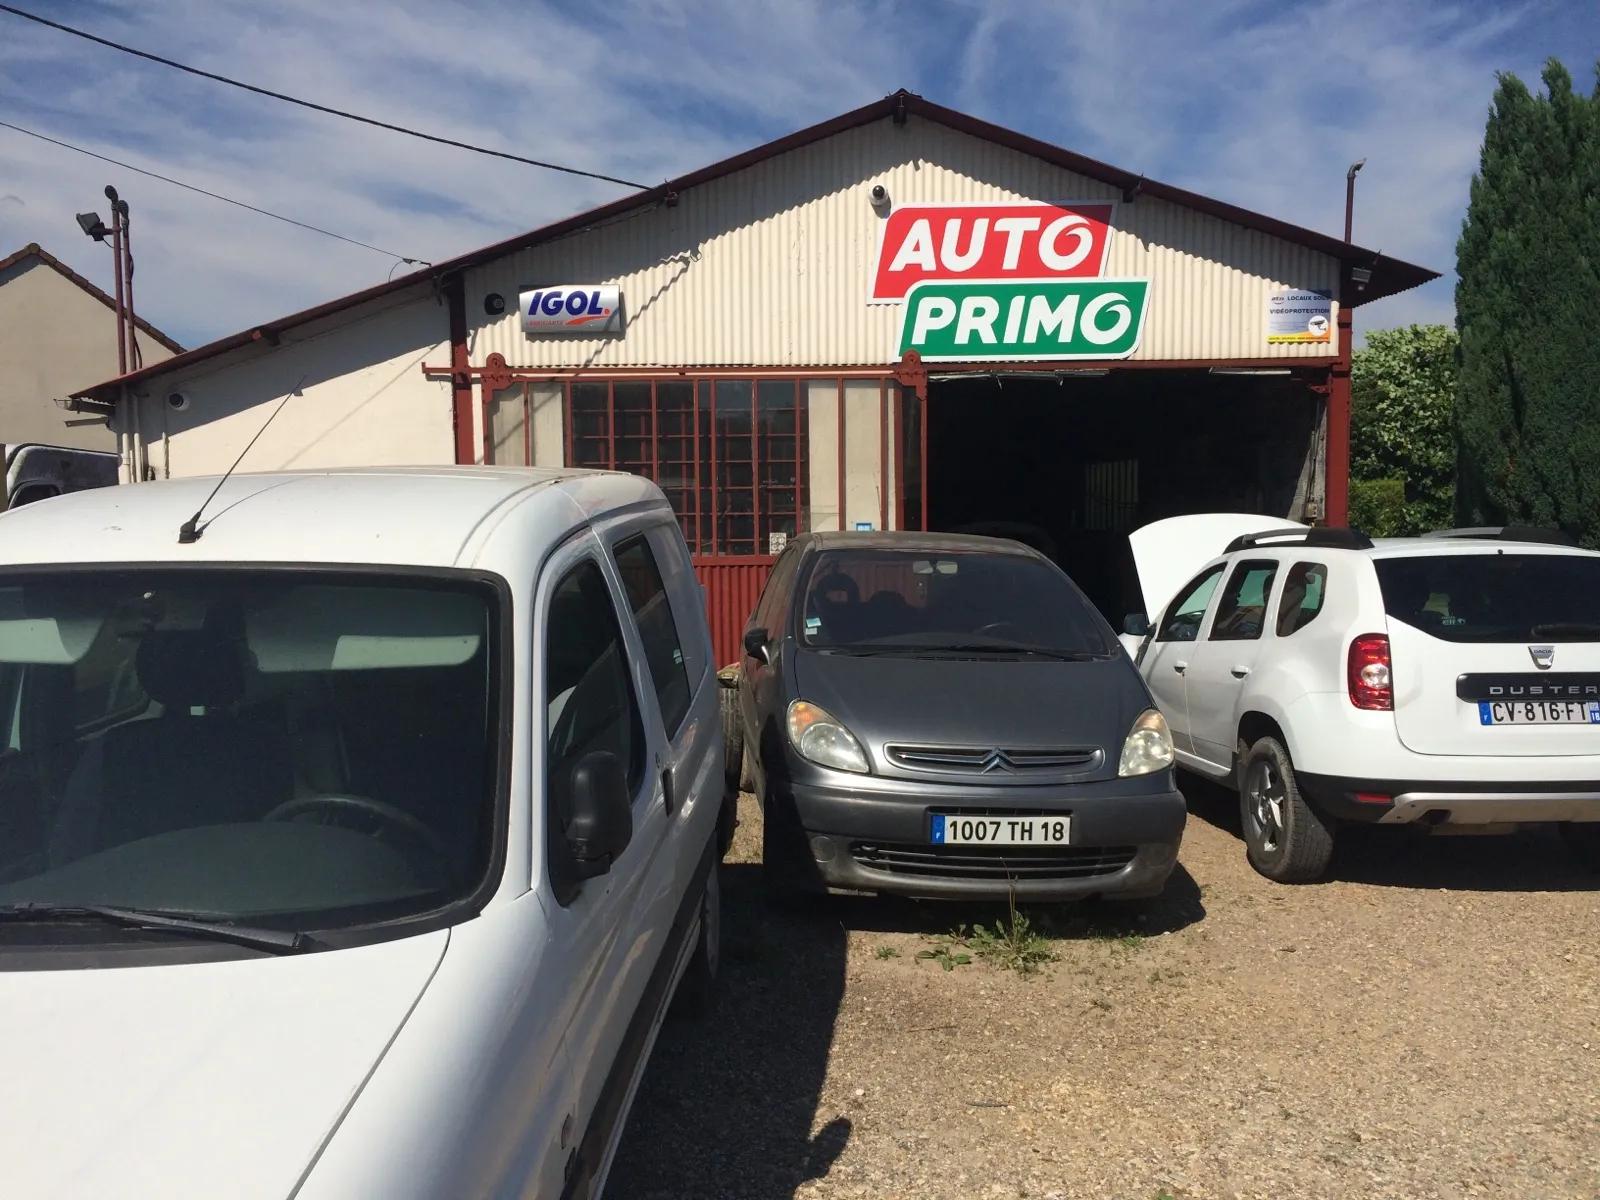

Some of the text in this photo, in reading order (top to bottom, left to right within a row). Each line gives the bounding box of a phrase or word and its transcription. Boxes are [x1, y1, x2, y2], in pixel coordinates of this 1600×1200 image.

[888, 214, 1094, 272] AUTO
[911, 292, 1133, 345] PRIMO
[1489, 686, 1598, 695] DUSTER
[949, 820, 1065, 842] 1007 TH 18
